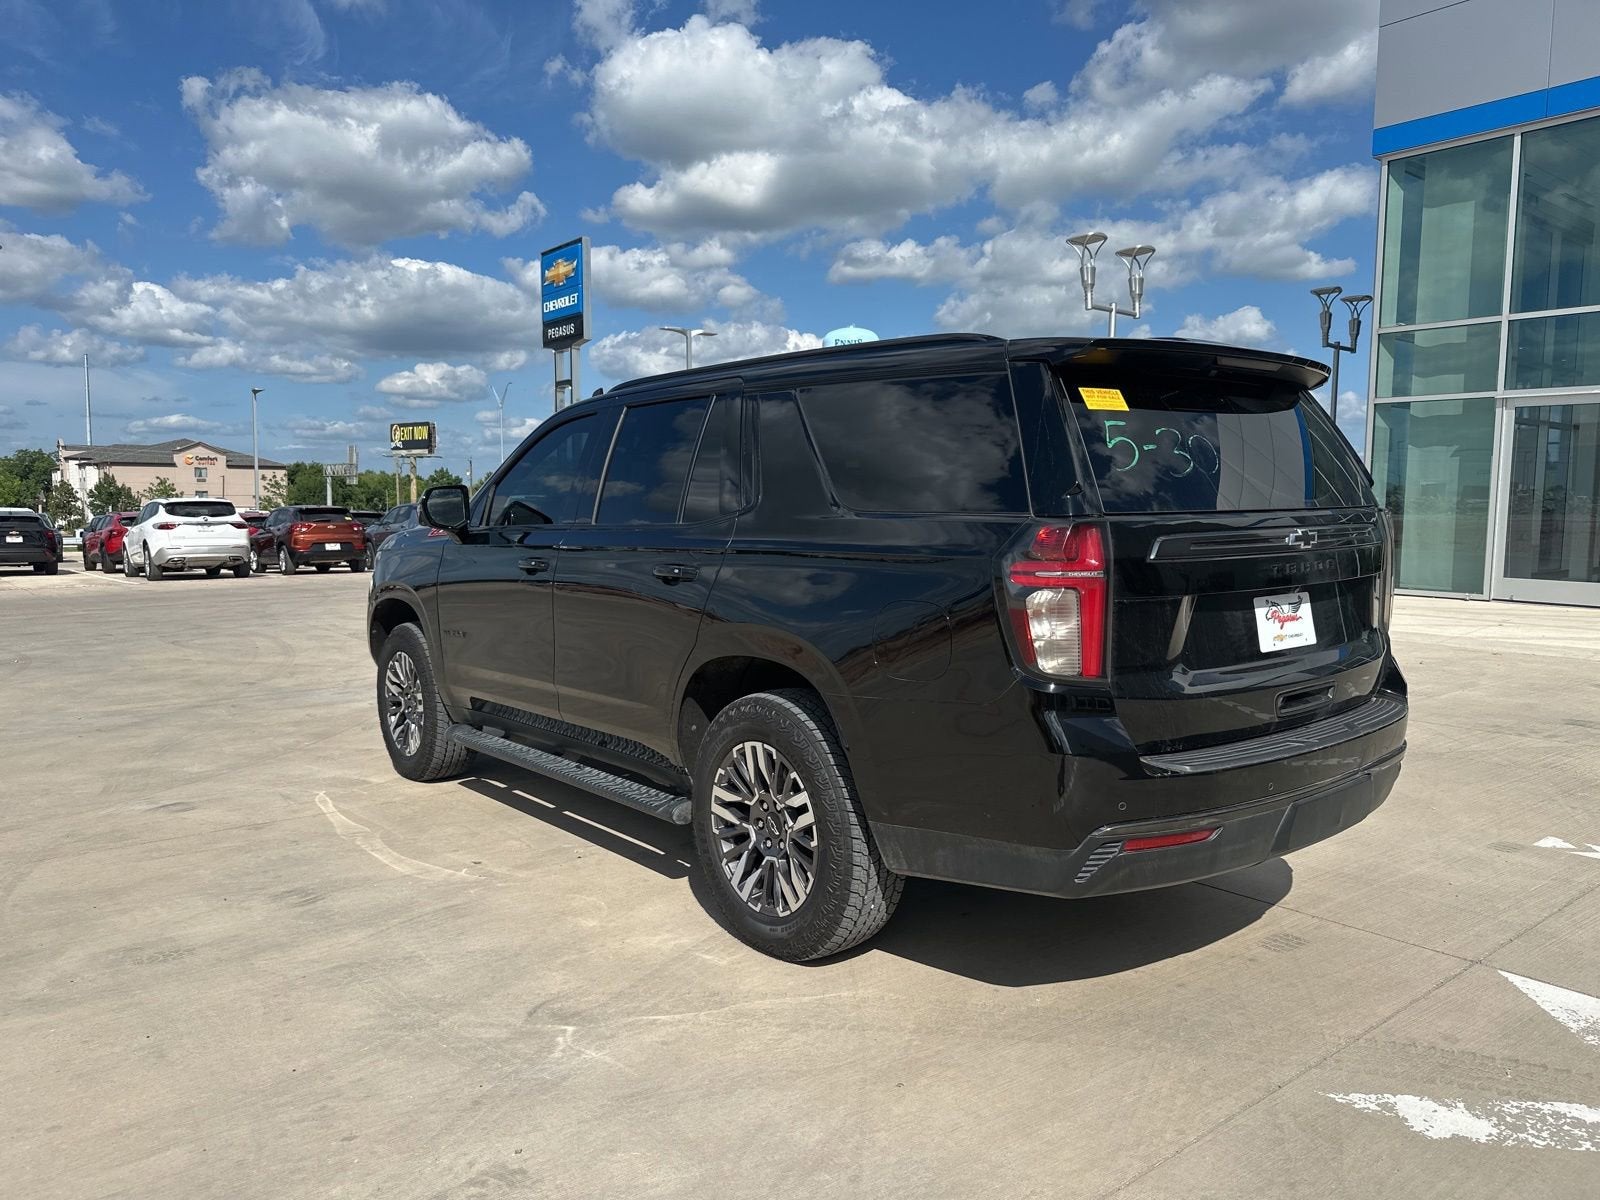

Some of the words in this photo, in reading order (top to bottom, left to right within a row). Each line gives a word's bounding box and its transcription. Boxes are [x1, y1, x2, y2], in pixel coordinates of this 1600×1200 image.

[543, 293, 578, 313] CHEVROLET
[548, 323, 575, 339] PEGASUS
[400, 426, 413, 440] EXIT
[414, 425, 429, 440] NOW
[1104, 420, 1219, 477] 5-30
